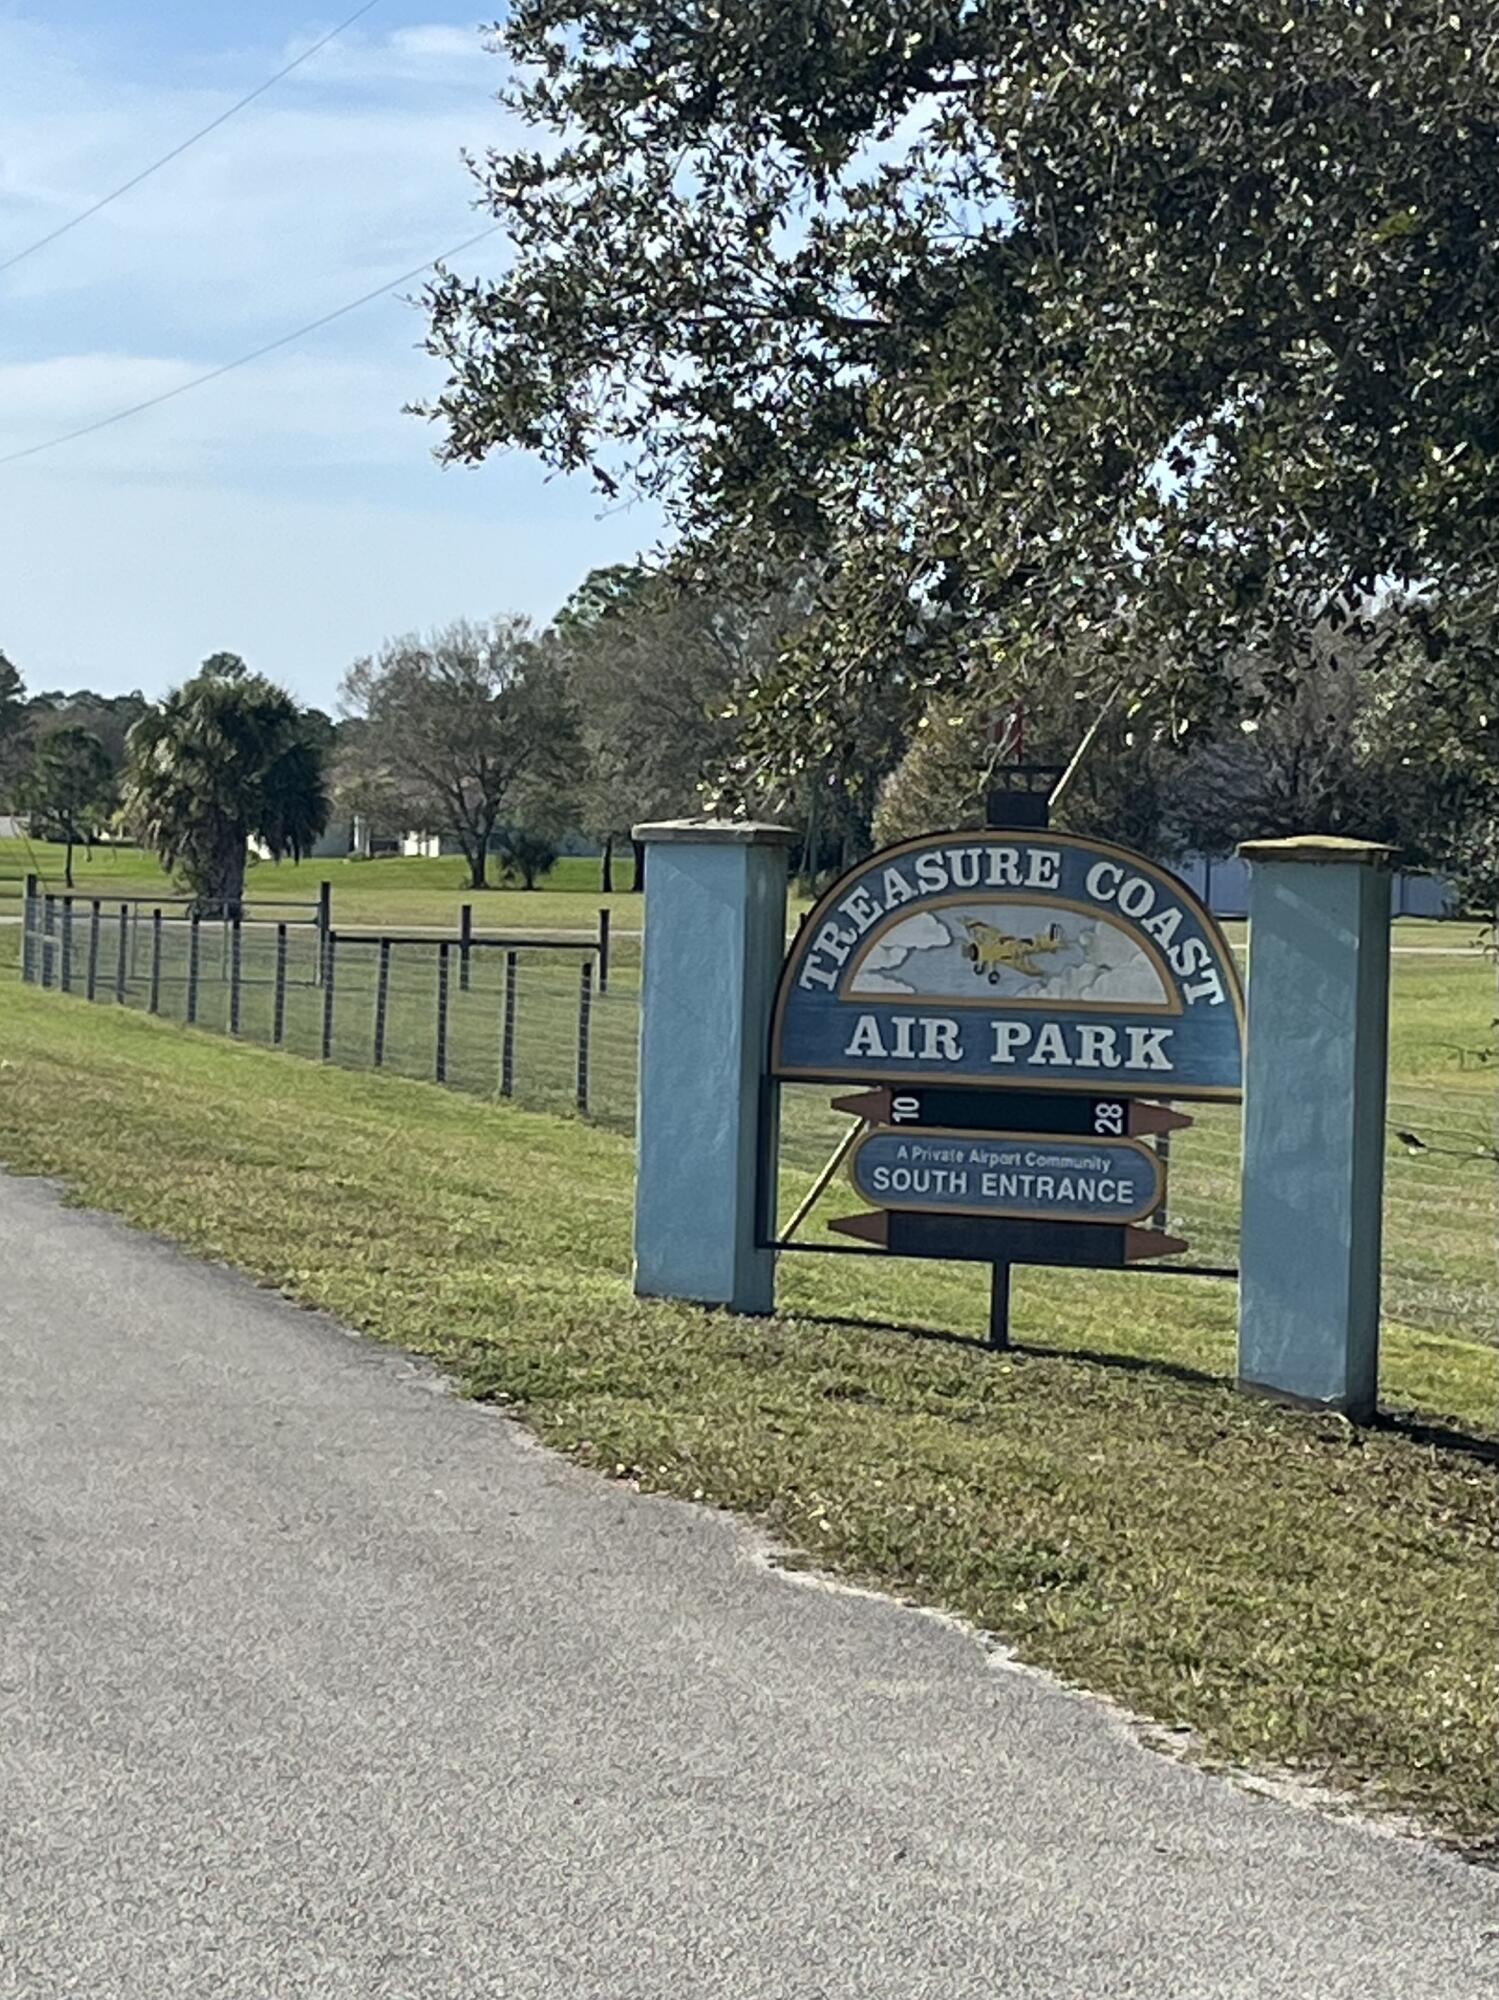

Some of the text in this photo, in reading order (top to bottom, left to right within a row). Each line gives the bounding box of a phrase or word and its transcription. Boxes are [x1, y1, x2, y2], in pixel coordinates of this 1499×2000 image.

[798, 847, 1226, 1007] TREASURE COAST
[844, 1014, 1175, 1071] AIR PARK
[892, 1096, 920, 1122] 10
[1094, 1102, 1123, 1135] 28
[897, 1145, 1111, 1174] A Private Airport Community
[872, 1167, 1135, 1204] SOUTH ENTRANCE
